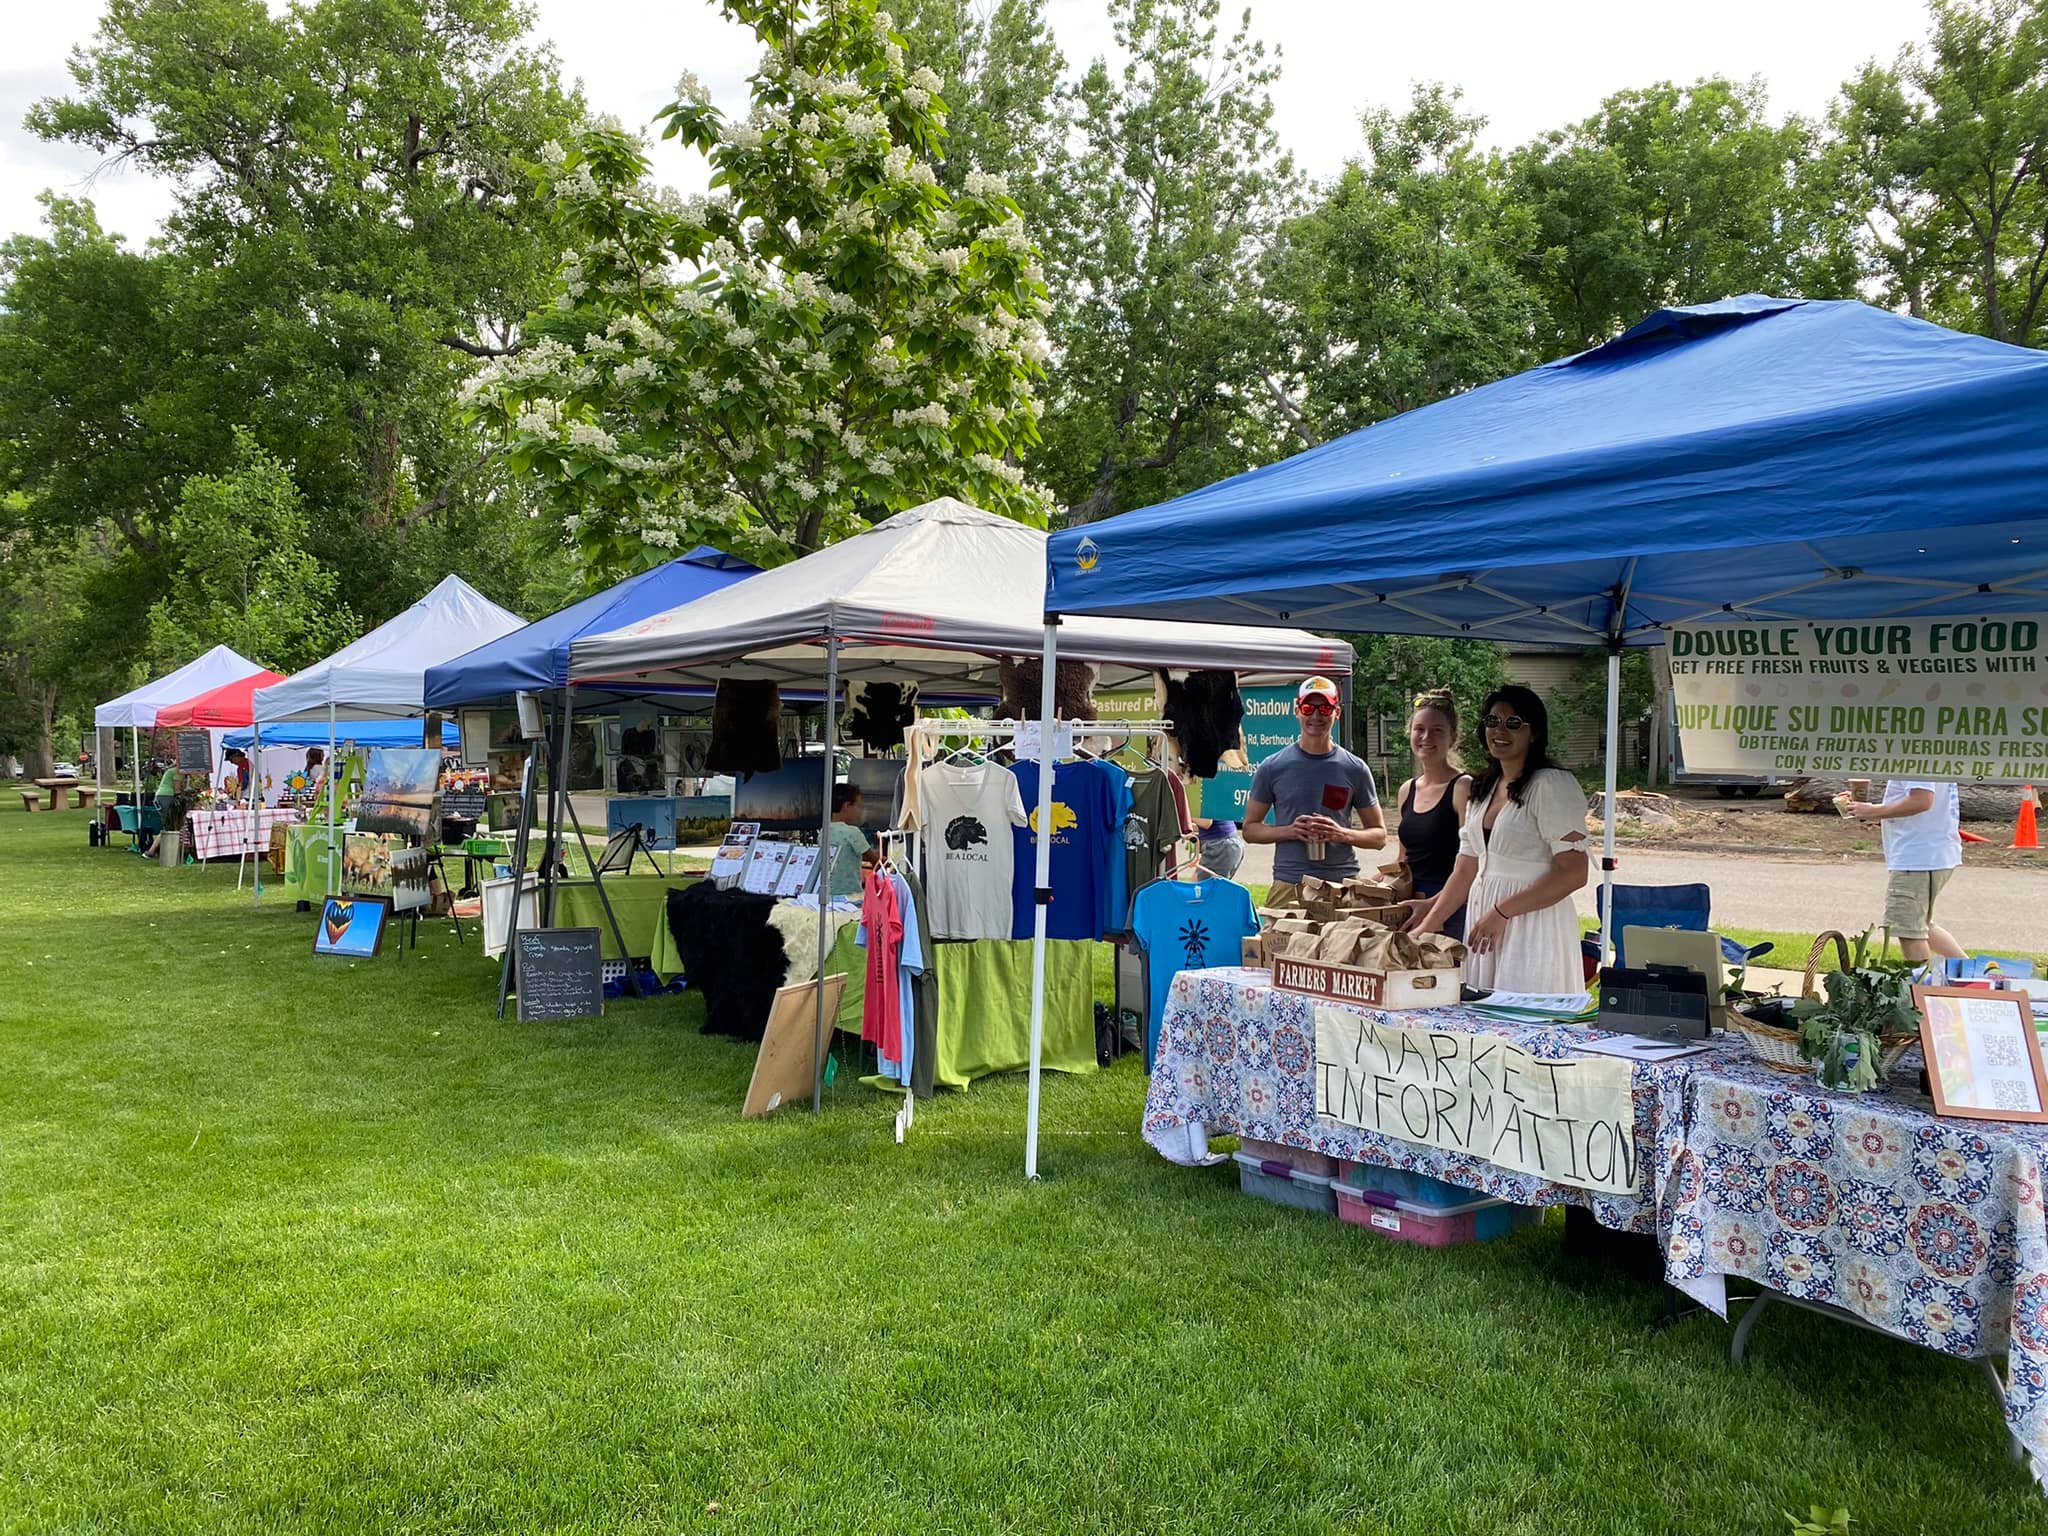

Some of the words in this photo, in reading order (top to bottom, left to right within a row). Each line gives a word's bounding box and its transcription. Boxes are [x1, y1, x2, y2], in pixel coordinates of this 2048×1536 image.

[1672, 628, 1800, 656] DOUBLE
[1814, 625, 1912, 655] YOUR
[1929, 621, 2039, 653] FOOD
[1672, 660, 1700, 674] GET
[1706, 660, 1745, 674] FREE
[1752, 660, 1803, 674] FRESH
[1809, 659, 1869, 674] FRUITS
[1877, 659, 1890, 674] &
[1897, 657, 1978, 674] VEGGIES
[1986, 656, 2036, 673] WITH
[1246, 698, 1291, 716] Shadow
[1788, 705, 1820, 733] SU
[1830, 705, 1926, 735] DINERO
[1936, 706, 2009, 736] PARA
[1739, 735, 1809, 752] OBTENGA
[1816, 737, 1878, 754] FRUTAS
[1885, 738, 1895, 754] Y
[1901, 738, 1991, 756] VERDURAS
[1775, 754, 1807, 769] CON
[1812, 756, 1843, 770] SUS
[1848, 757, 1965, 776] ESTAMPILLAS
[1971, 761, 1996, 777] DE
[962, 853, 988, 862] LOCAL
[1279, 963, 1327, 992] FARMERS
[1332, 971, 1377, 1001] MARKET
[1355, 1020, 1577, 1115] MARKET
[1318, 1061, 1637, 1189] INFORMATION
